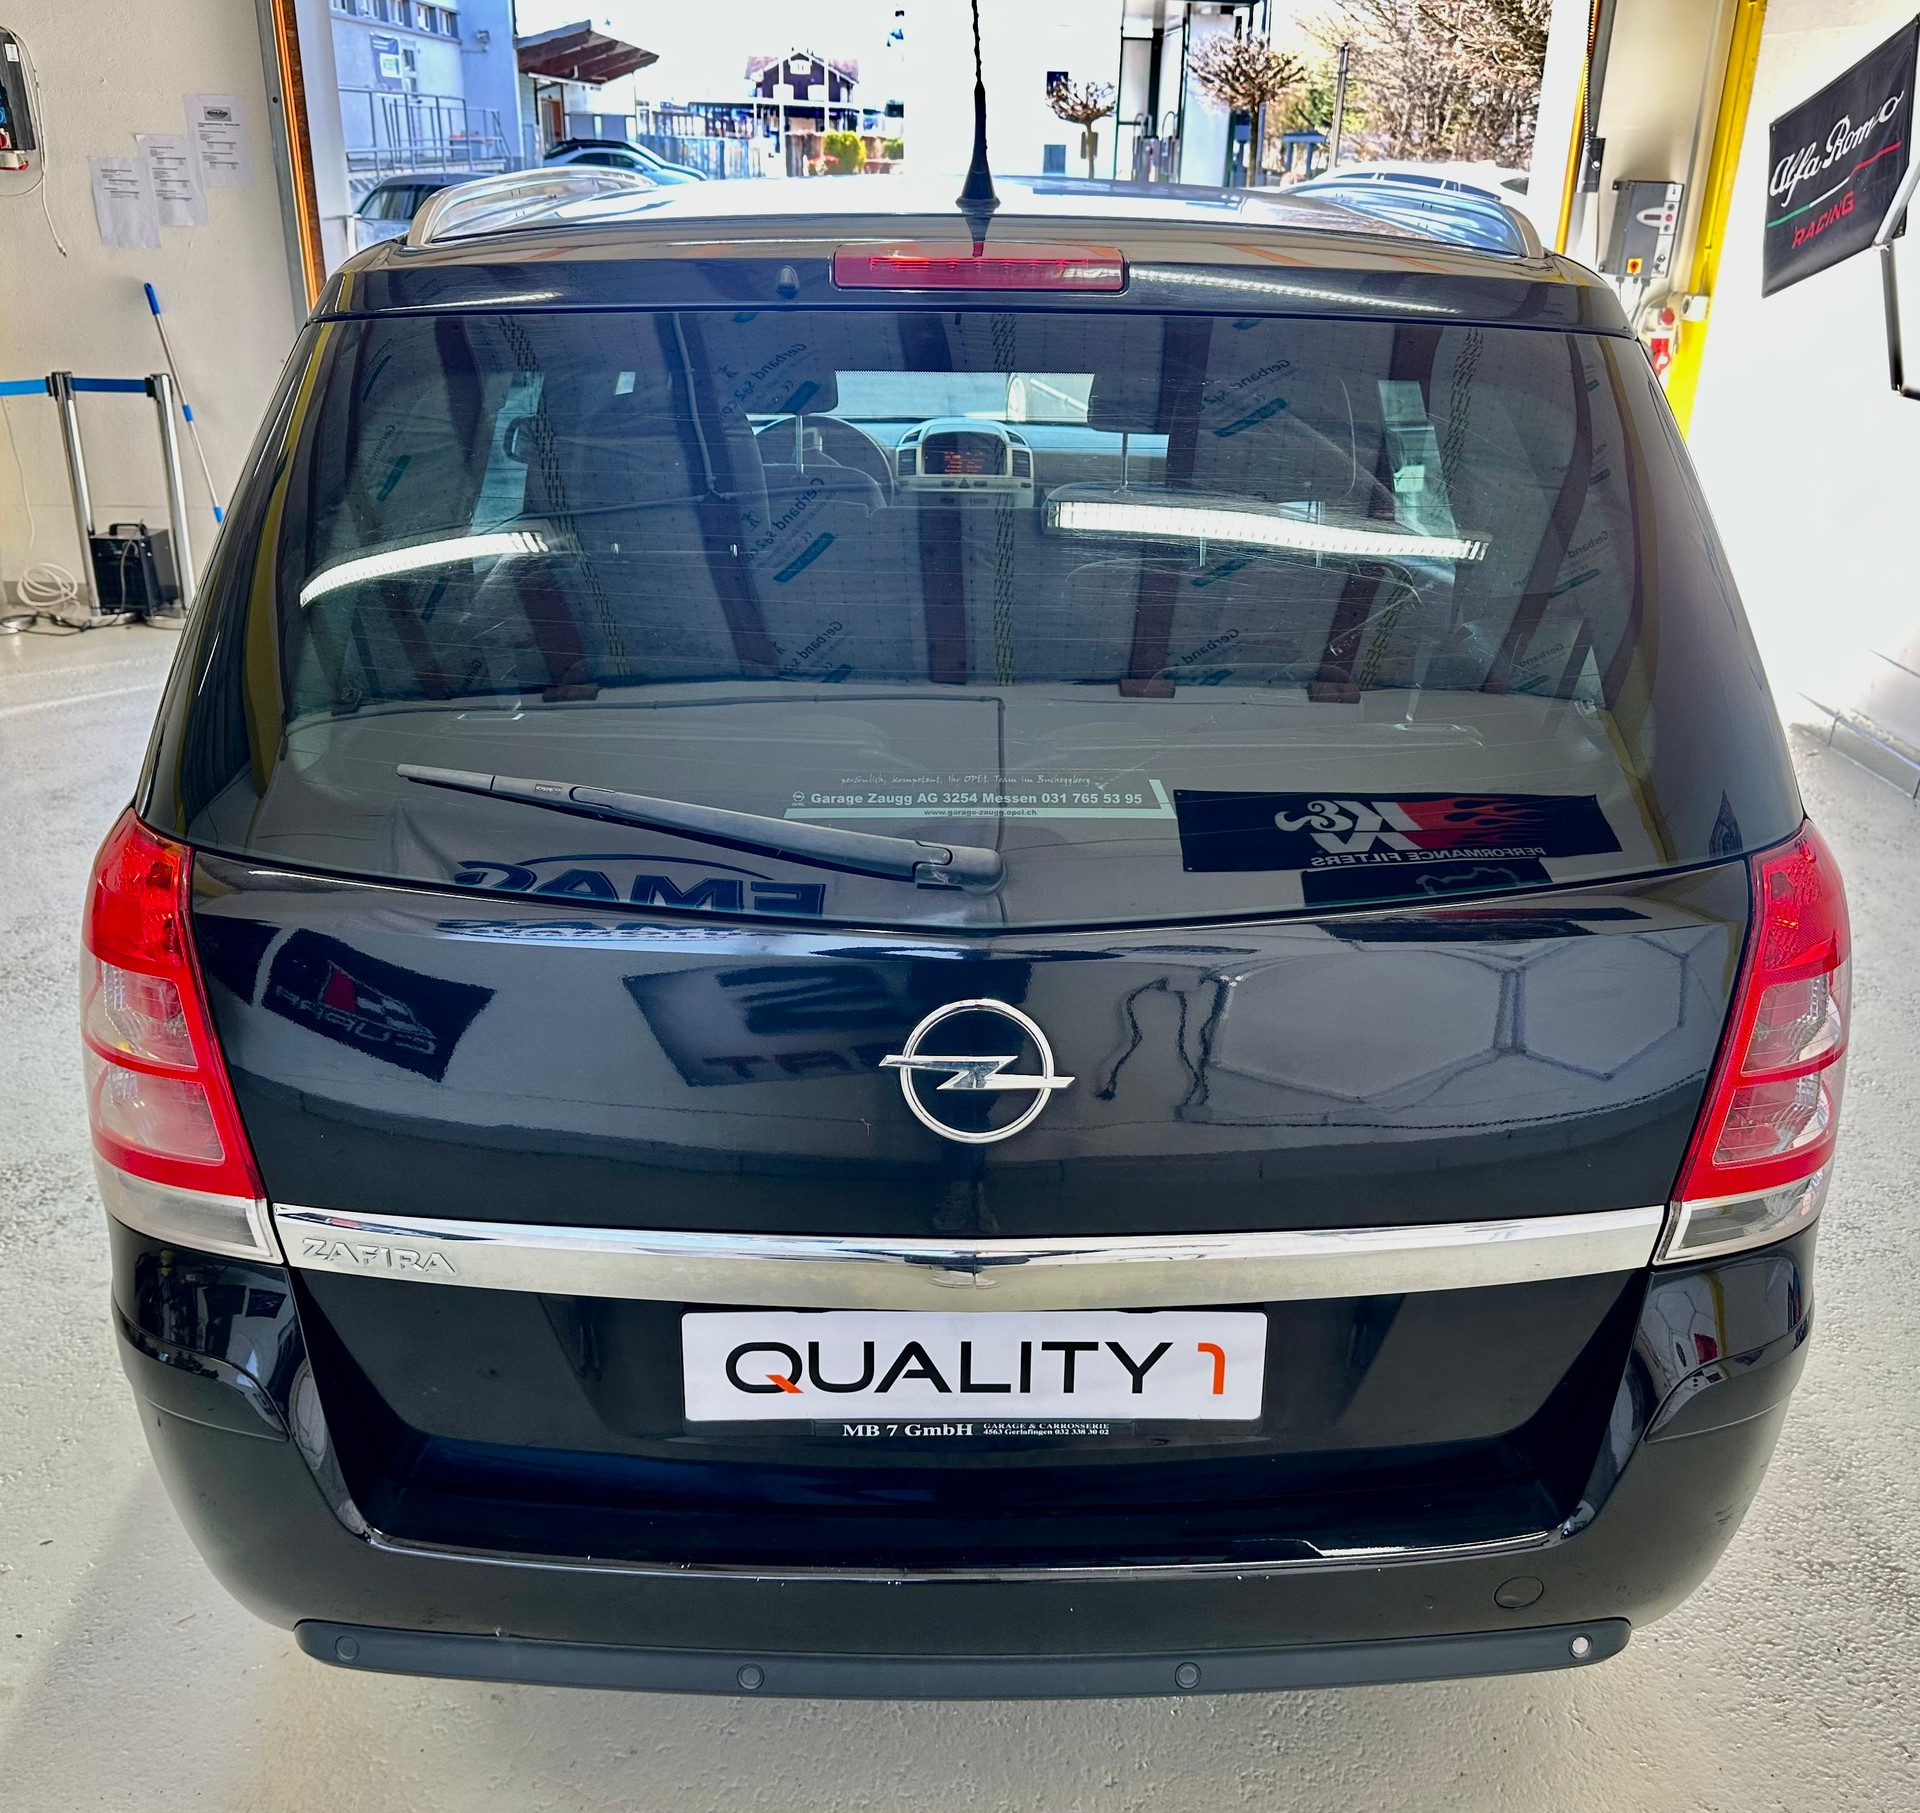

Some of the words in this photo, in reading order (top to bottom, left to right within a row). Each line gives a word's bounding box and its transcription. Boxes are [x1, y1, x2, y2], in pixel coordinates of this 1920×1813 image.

[1770, 142, 1823, 208] Alfa
[1791, 190, 1855, 250] RACING
[892, 774, 943, 786] kompetent,
[963, 774, 989, 783] OPEL
[993, 774, 1017, 783] Team
[810, 793, 863, 805] Garage
[867, 793, 912, 805] Zaugg
[916, 793, 938, 804] AG
[942, 793, 978, 804] 3254
[982, 793, 1037, 804] Messen
[1041, 793, 1067, 804] 031
[1072, 793, 1099, 804] 765
[1103, 793, 1120, 804] 53
[1124, 793, 1143, 804] 95
[923, 809, 1037, 817] www.garage-zaugg.opel.ch
[302, 1237, 457, 1274] ZAFIRA
[725, 1341, 1174, 1394] QUALITY
[1198, 1342, 1226, 1395] 1
[842, 1424, 880, 1437] MB
[886, 1424, 899, 1437] 7
[904, 1423, 974, 1438] GmbH
